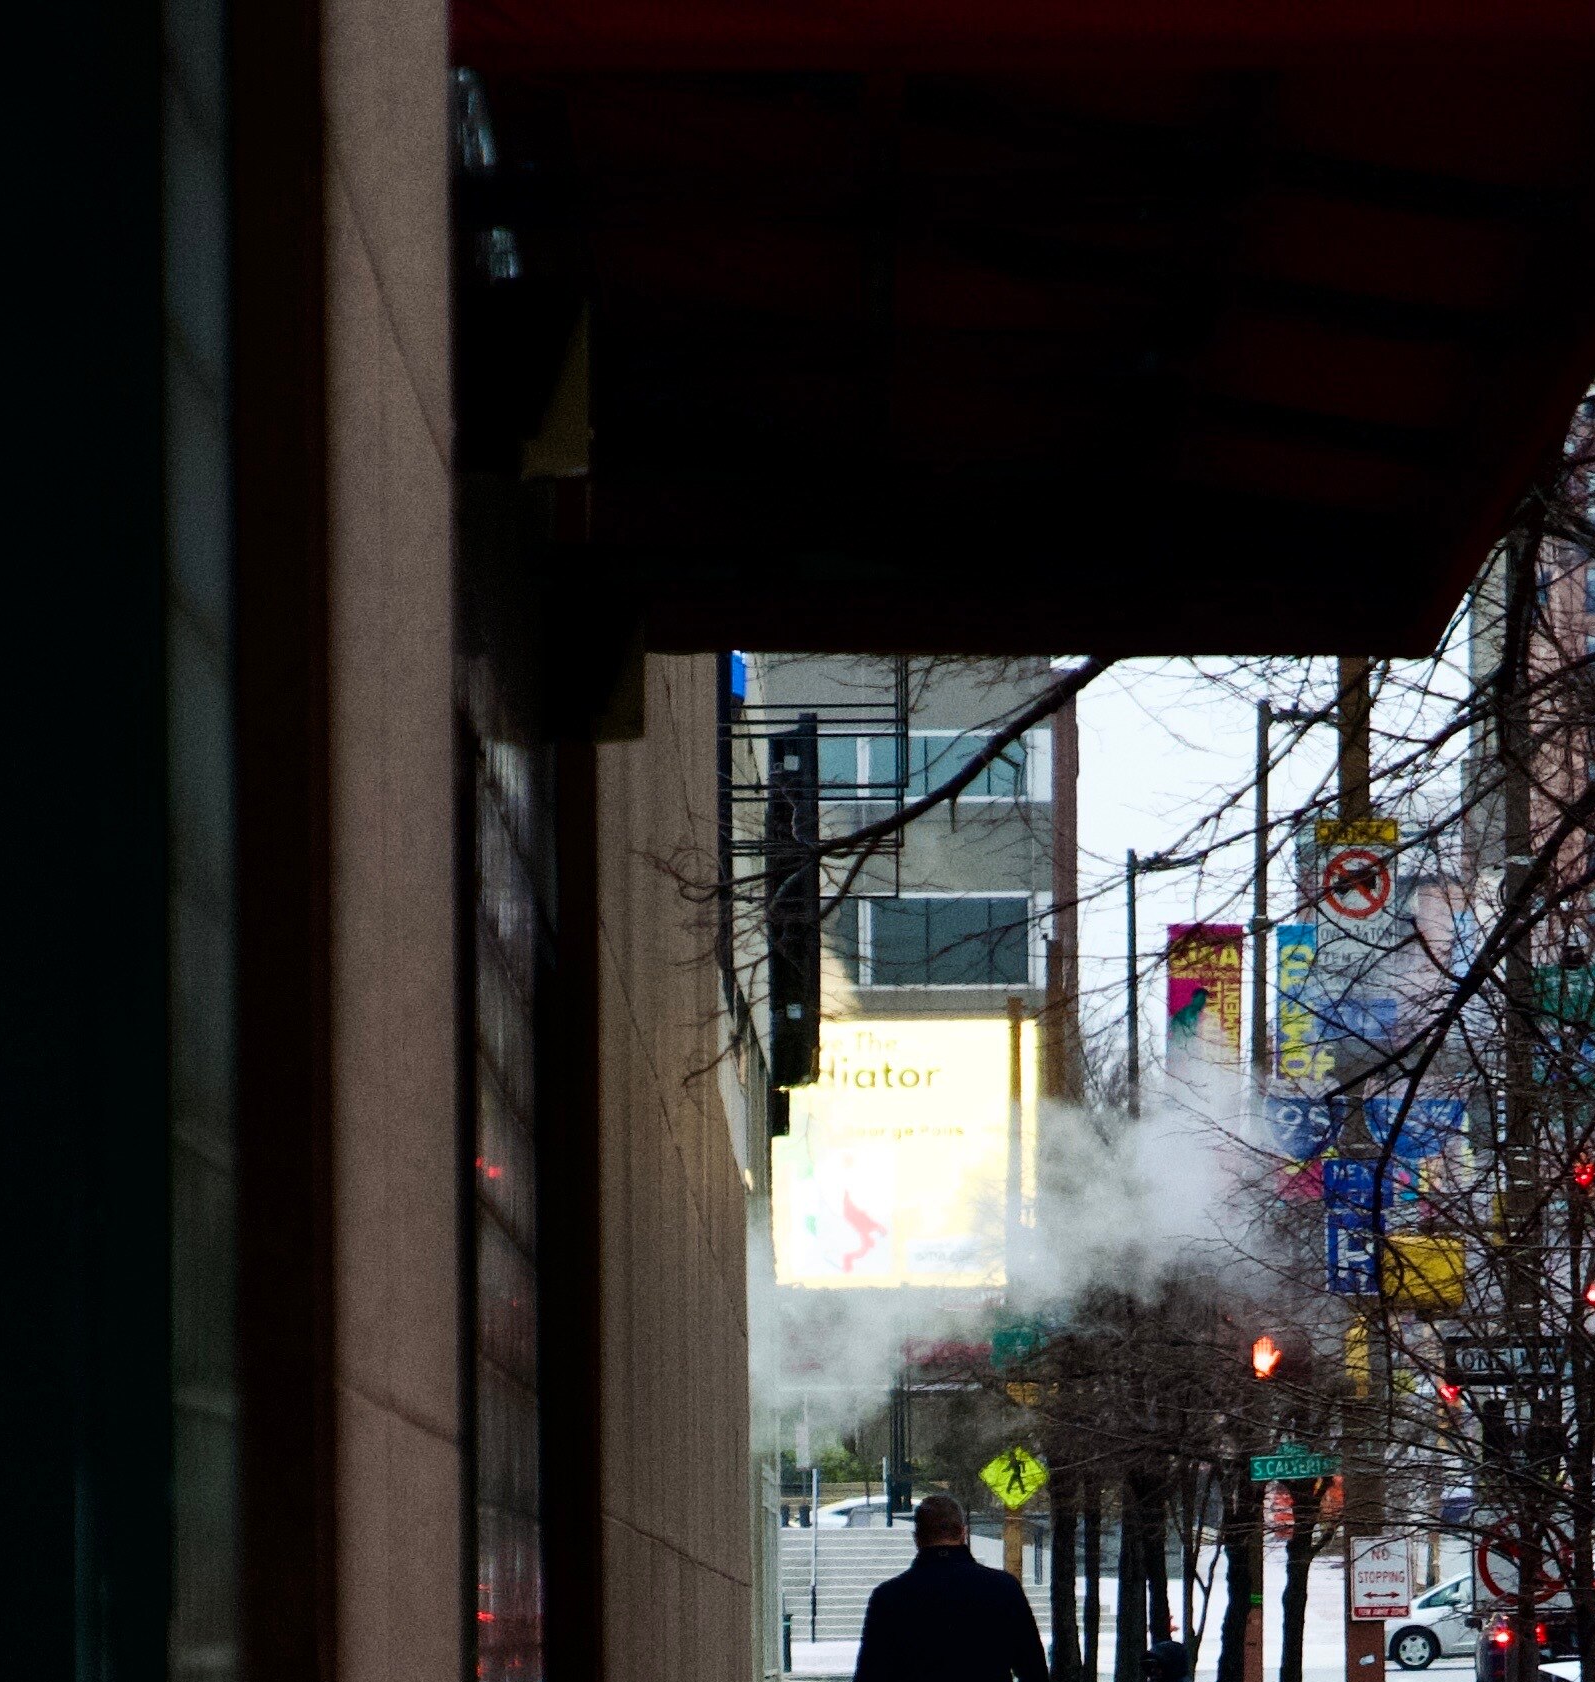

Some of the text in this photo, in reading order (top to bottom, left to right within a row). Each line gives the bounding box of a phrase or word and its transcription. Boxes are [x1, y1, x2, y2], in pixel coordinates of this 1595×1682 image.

[818, 1055, 942, 1088] diator
[1254, 1461, 1263, 1477] S
[1371, 1545, 1391, 1561] NO
[1357, 1570, 1406, 1585] STOPPING
